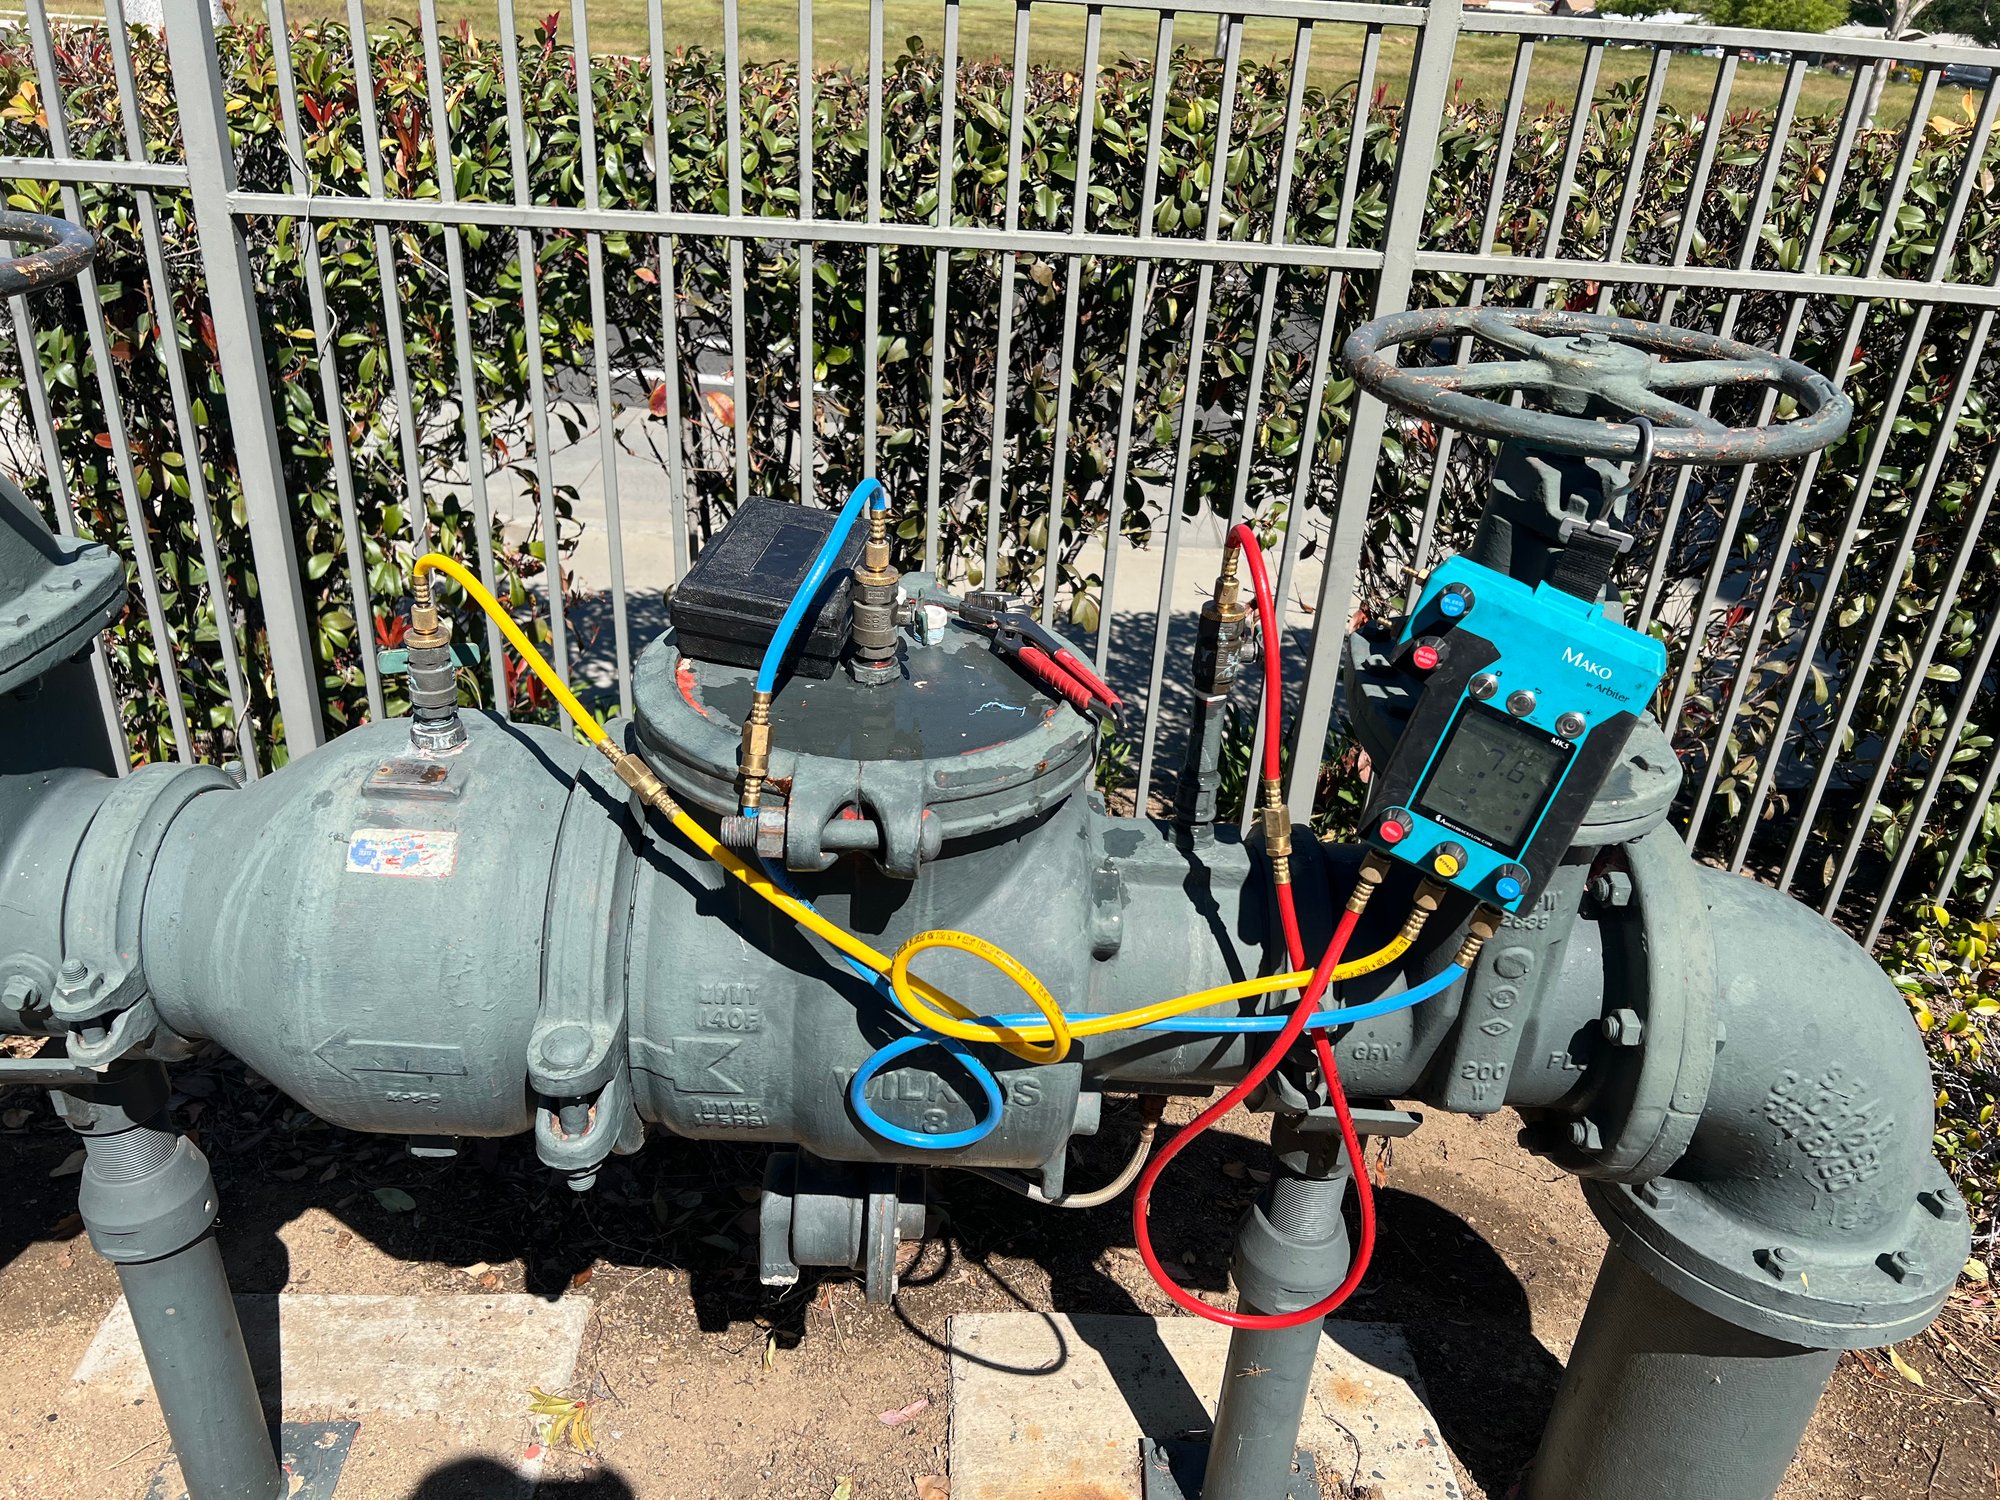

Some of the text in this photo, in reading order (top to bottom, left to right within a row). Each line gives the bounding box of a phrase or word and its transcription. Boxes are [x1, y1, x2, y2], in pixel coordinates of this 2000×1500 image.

[1561, 646, 1613, 680] MAKO
[1594, 681, 1631, 704] Arbiter
[1550, 736, 1570, 750] MK5
[1485, 747, 1532, 785] 7.6
[1437, 857, 1456, 874] BYPASS
[1461, 1059, 1508, 1080] 200
[764, 1263, 793, 1271] VENT
